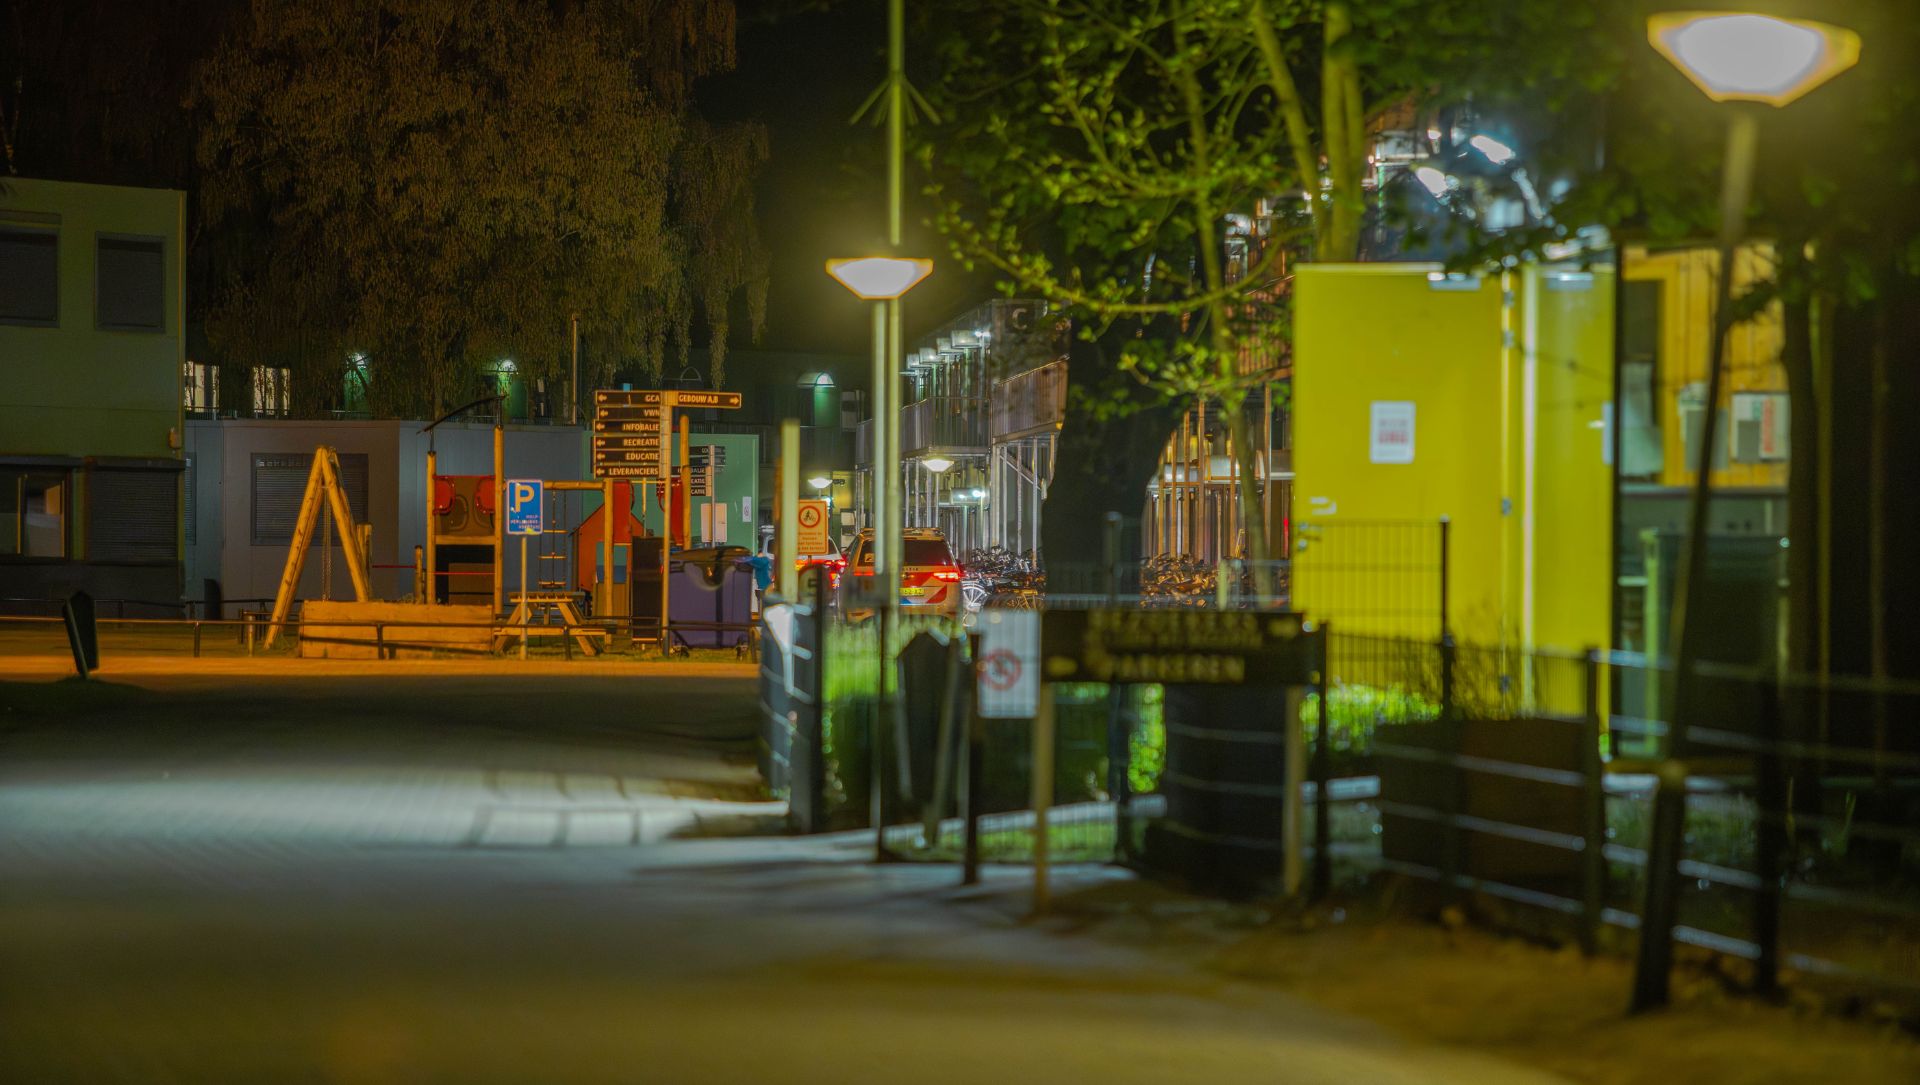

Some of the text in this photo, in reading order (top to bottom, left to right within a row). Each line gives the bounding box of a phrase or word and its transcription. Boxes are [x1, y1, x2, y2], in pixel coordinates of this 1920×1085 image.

[1012, 308, 1027, 330] C
[645, 394, 660, 403] GCA
[679, 394, 707, 403] GEBOUW
[623, 423, 660, 431] INFOBALIE
[623, 438, 660, 446] RECREATIE
[626, 452, 660, 460] EDUCATIE
[609, 467, 659, 475] LEVERANCIERS
[515, 485, 535, 512] P
